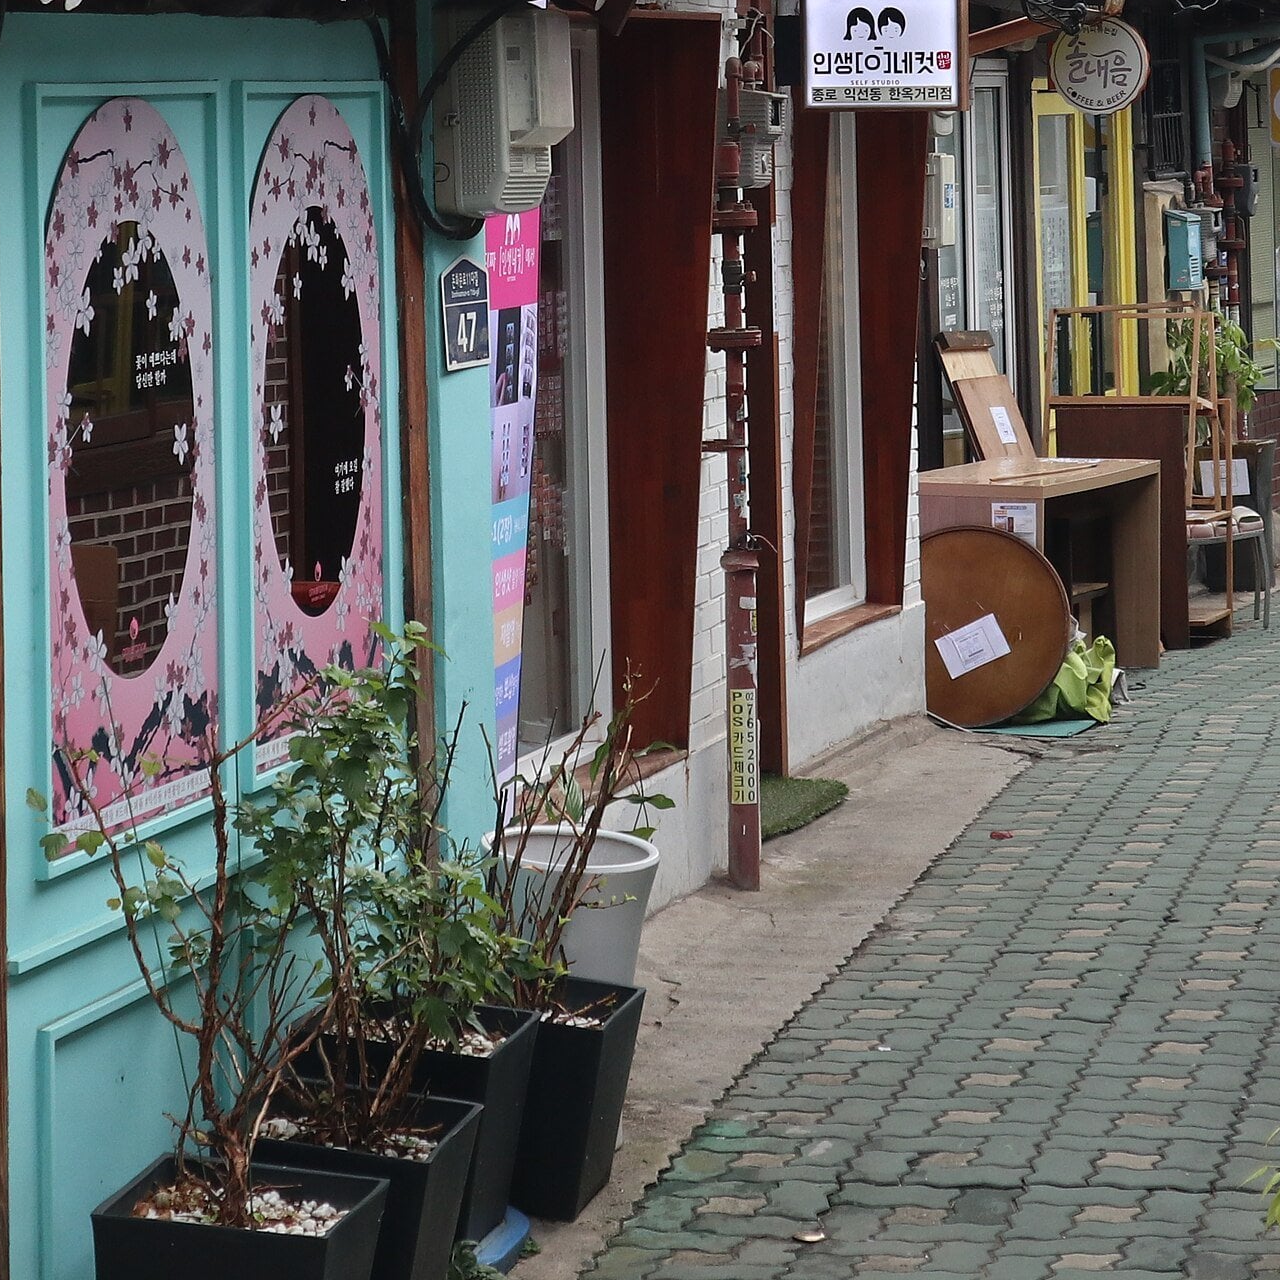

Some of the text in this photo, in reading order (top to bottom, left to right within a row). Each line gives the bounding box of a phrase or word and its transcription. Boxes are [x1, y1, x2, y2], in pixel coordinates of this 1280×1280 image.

[812, 87, 952, 102] 종로 익선동 한옥거리점
[1066, 86, 1095, 107] COFFEE
[1106, 89, 1127, 106] BEER
[457, 311, 477, 353] 47
